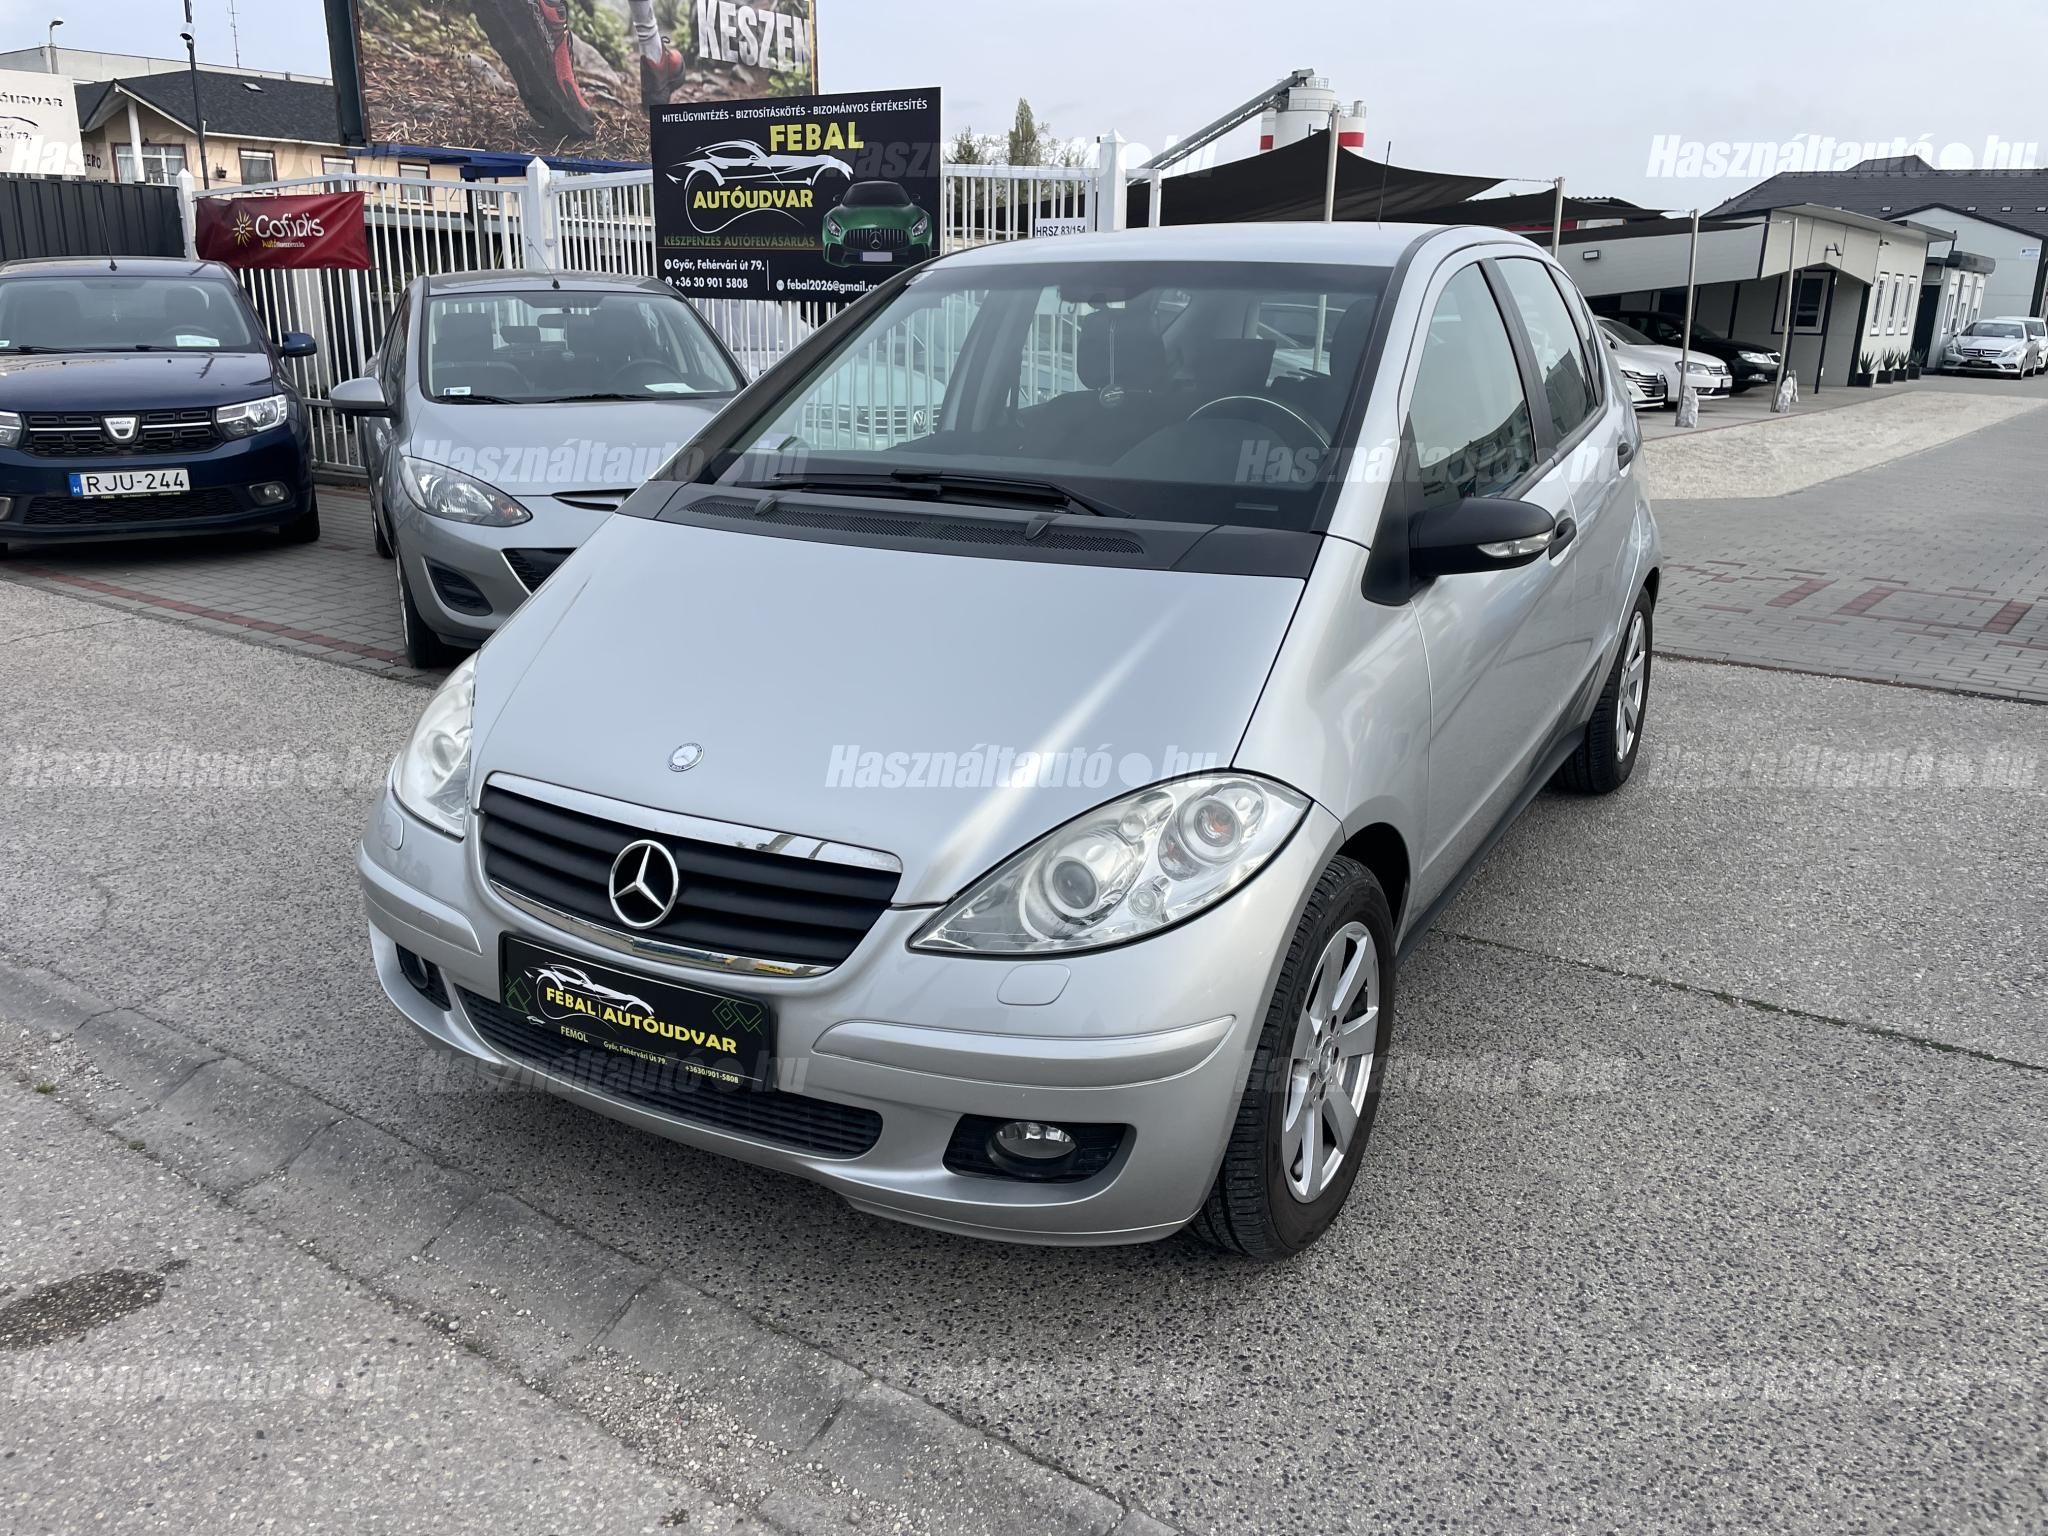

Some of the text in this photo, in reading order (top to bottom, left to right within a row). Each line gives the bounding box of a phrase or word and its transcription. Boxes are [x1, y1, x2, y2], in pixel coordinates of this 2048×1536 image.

[662, 109, 729, 123] HITELÜGYINTÉZÉS
[736, 104, 806, 119] BIZTOSÍTÁSKÖTÉS
[813, 102, 869, 115] BIZOMÁNYOS
[870, 98, 928, 112] ÉRTÉKESÍTÉS
[769, 121, 865, 152] FEBAL
[693, 185, 813, 209] AUTÓUDVAR
[255, 212, 325, 238] Cofidis
[1036, 226, 1059, 237] HRSZ
[697, 258, 737, 270] Fehérvári
[740, 260, 748, 270] út
[750, 260, 765, 270] 79.
[675, 277, 748, 289] +36 30 901 5808
[86, 472, 184, 493] RJU-244
[546, 987, 737, 1054] FEBAL AUTÓUDVAR
[560, 1025, 588, 1043] FEMOL
